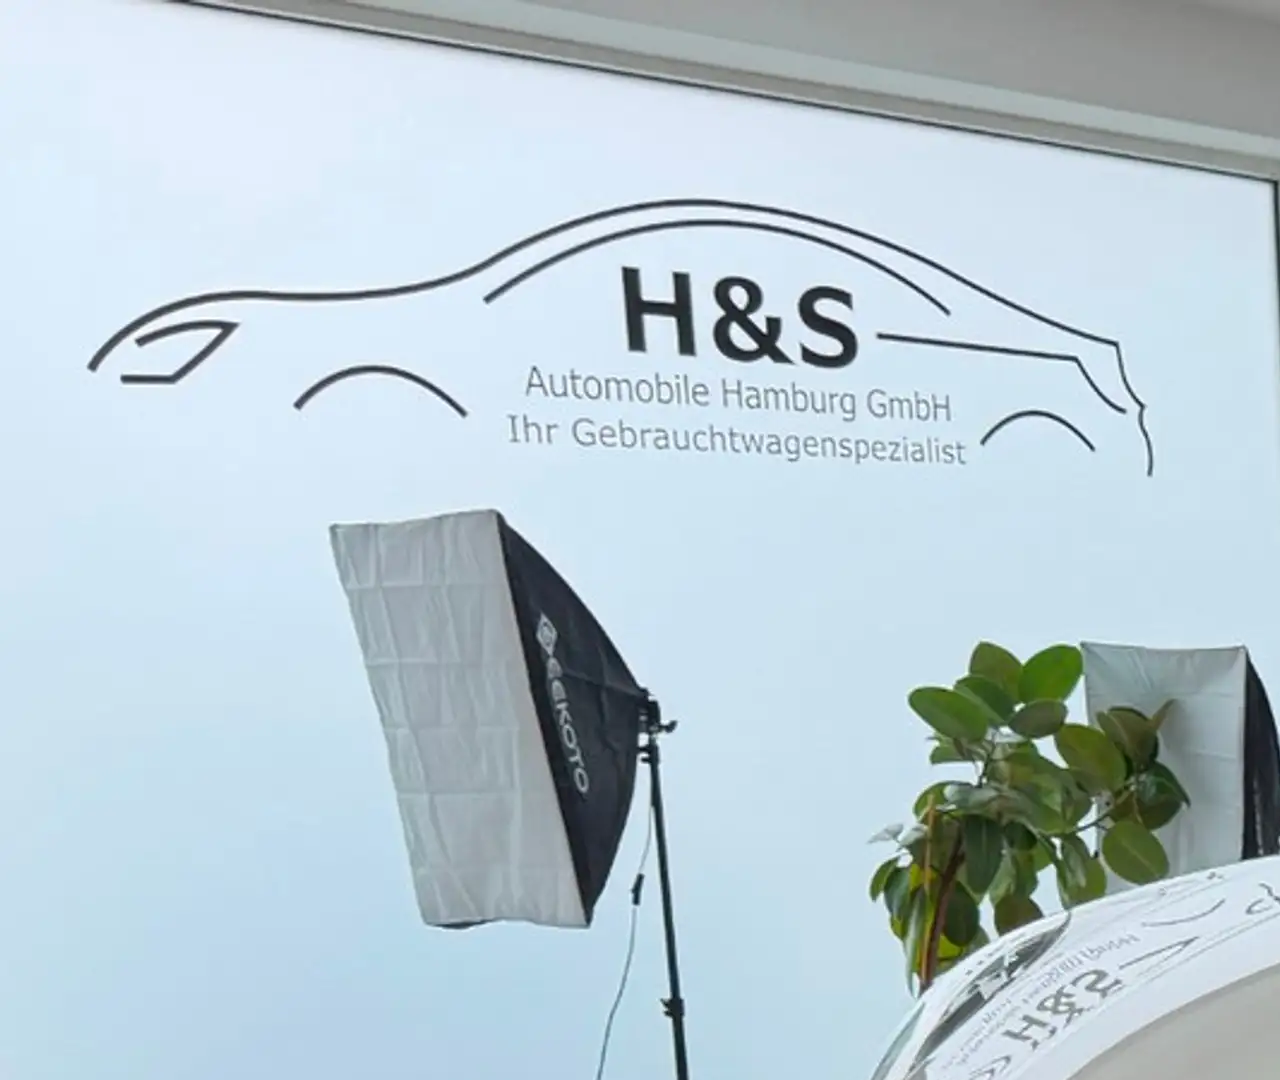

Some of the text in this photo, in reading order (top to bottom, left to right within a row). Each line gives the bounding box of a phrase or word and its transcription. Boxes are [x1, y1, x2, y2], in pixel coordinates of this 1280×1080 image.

[620, 266, 859, 369] H&S
[524, 365, 952, 422] Automobile Hamburg GmbH
[506, 414, 967, 465] Ihr Gebrauchtwagenspezialist
